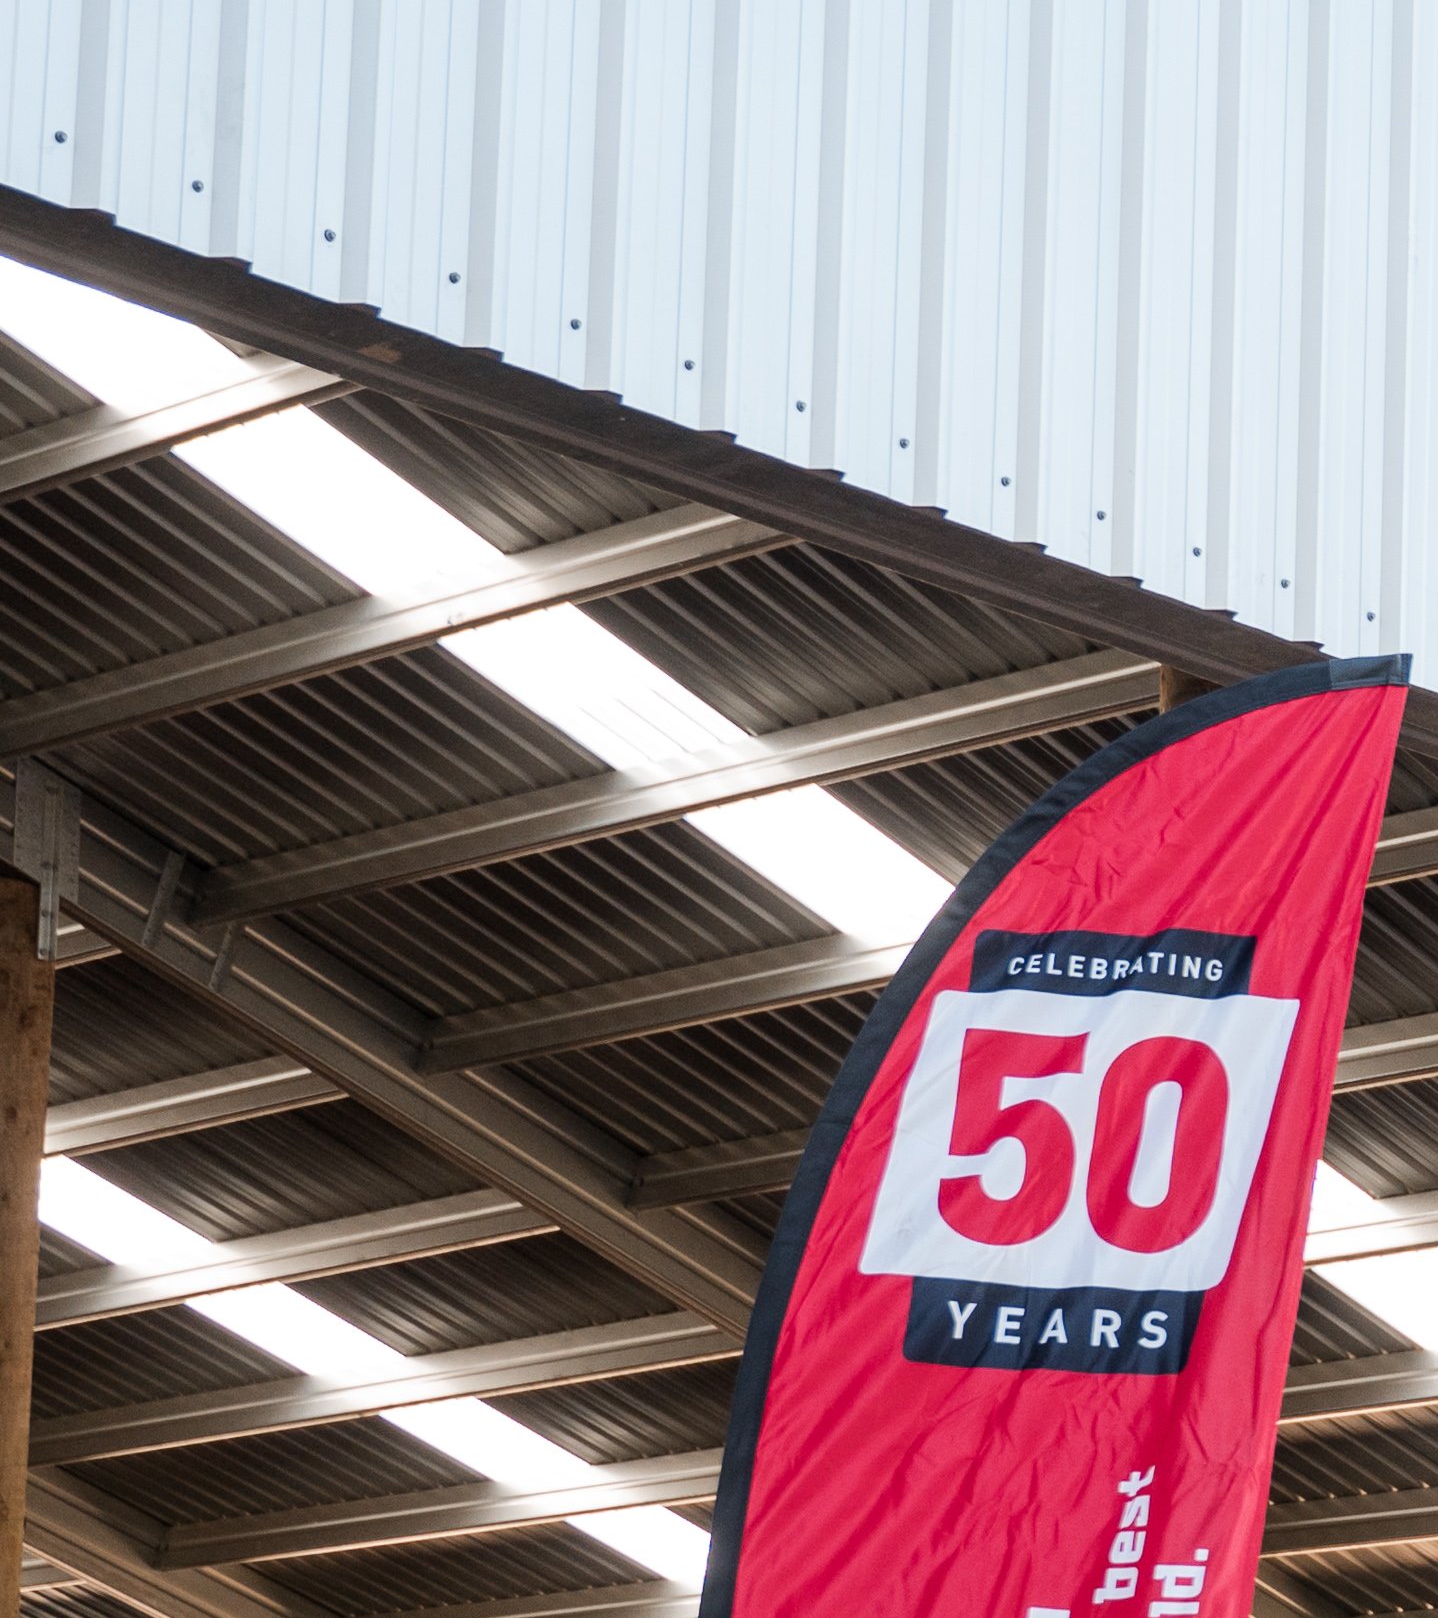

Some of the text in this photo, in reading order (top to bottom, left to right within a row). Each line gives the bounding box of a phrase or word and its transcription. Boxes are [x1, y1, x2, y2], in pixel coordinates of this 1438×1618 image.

[1007, 951, 1226, 983] CELEBRATING
[936, 1026, 1230, 1256] 50
[948, 1299, 1169, 1350] YEARS
[1092, 1464, 1156, 1605] best
